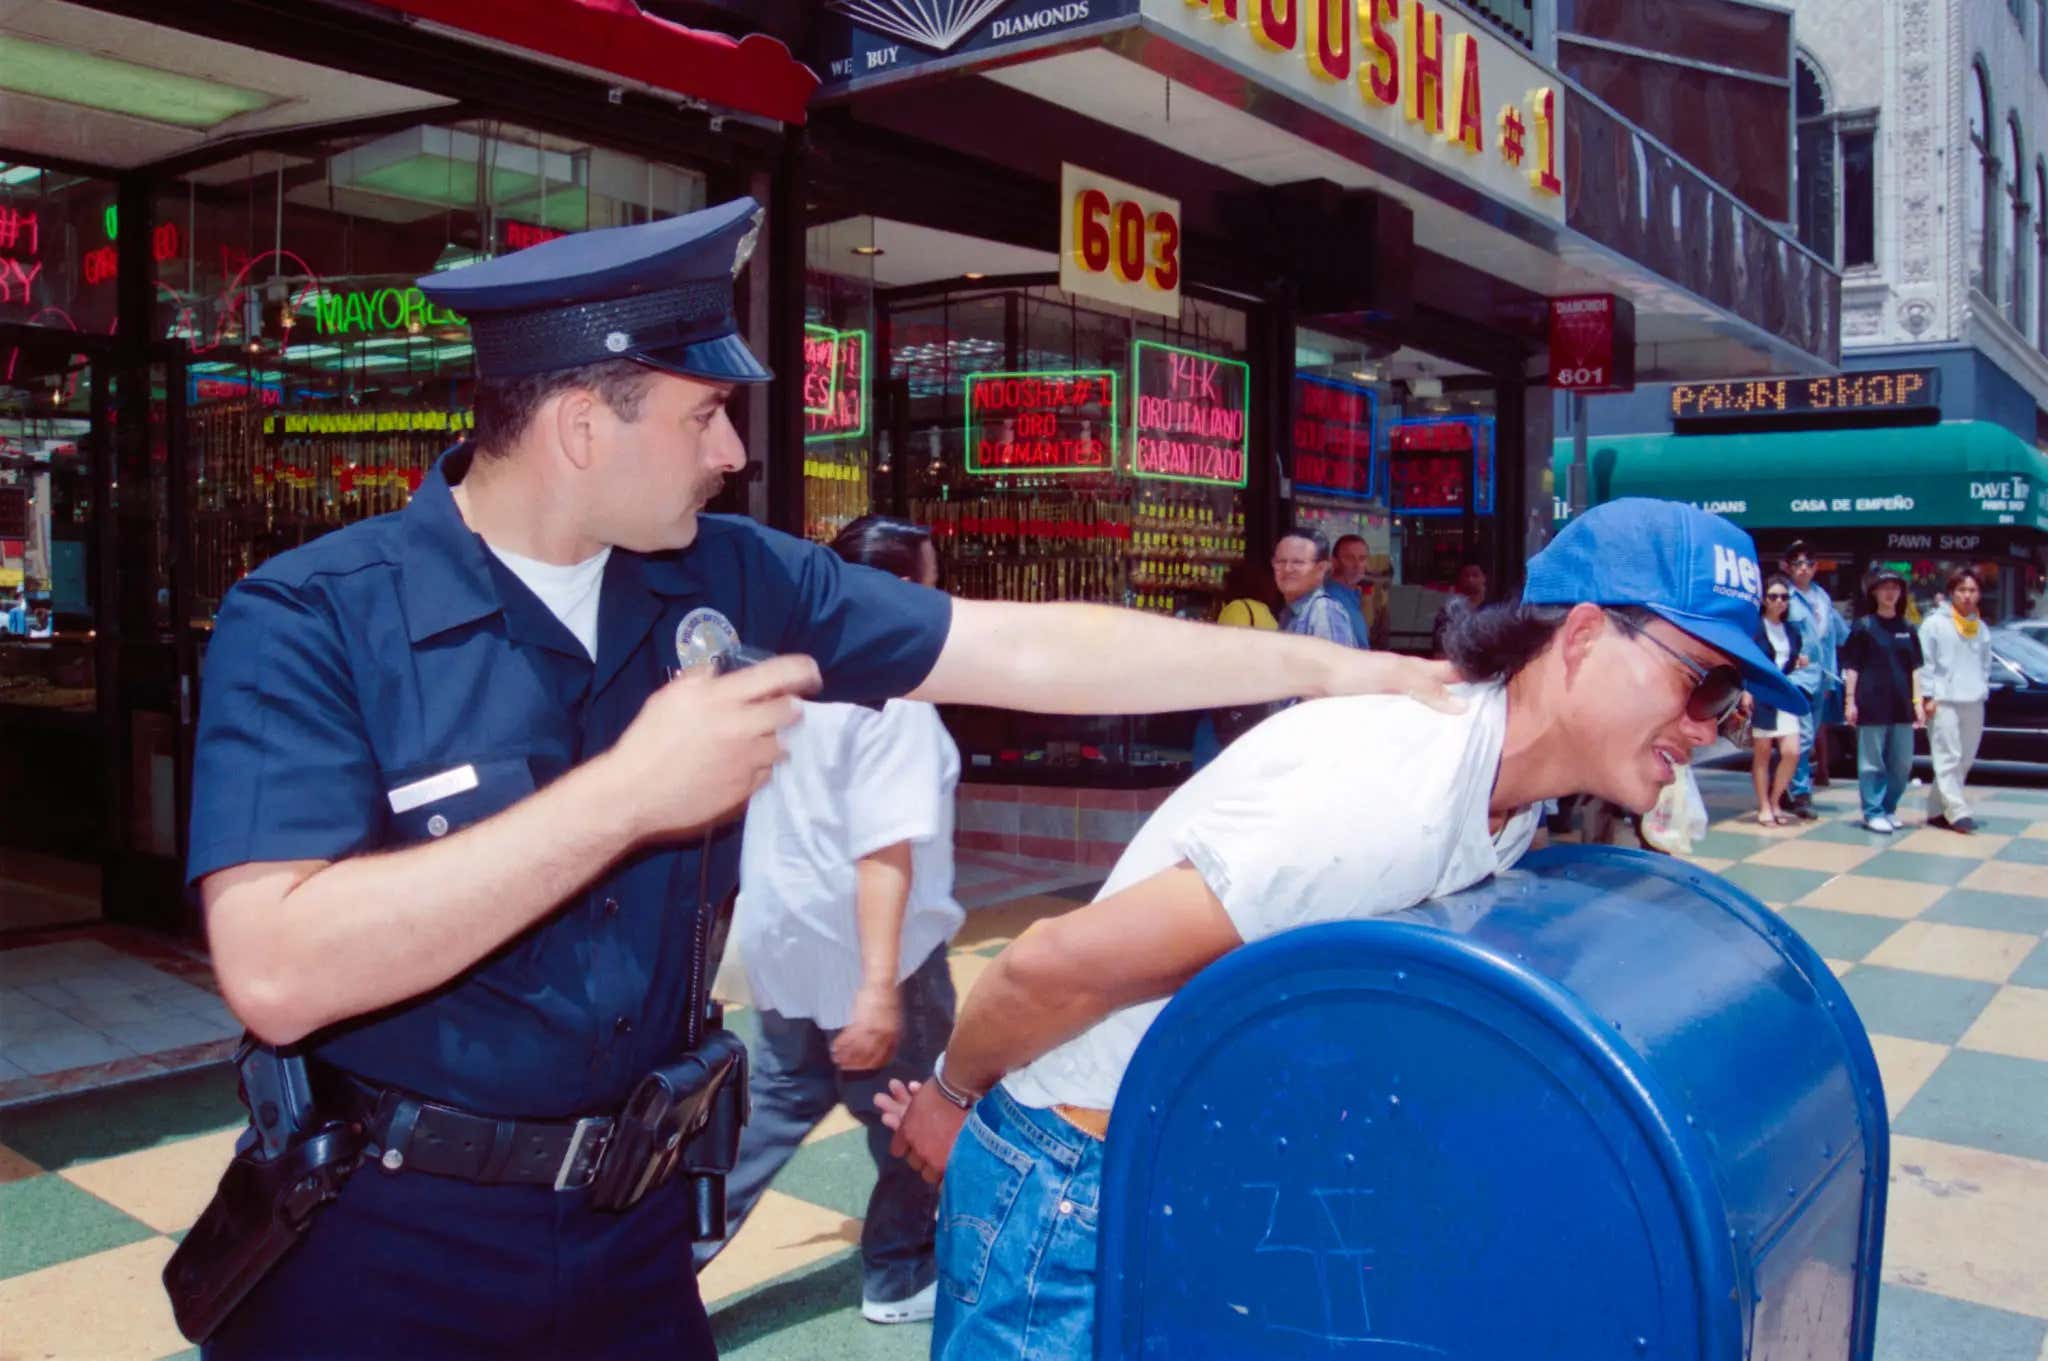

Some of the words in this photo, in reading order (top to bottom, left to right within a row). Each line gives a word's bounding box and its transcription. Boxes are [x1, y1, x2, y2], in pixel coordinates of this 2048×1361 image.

[831, 58, 852, 75] WE
[867, 46, 899, 68] BUY
[992, 1, 1089, 39] DIAMONDS
[1497, 86, 1561, 196] #1
[1073, 189, 1178, 291] 603
[1558, 367, 1602, 385] 601
[1672, 379, 1786, 415] PAWN
[1704, 500, 1748, 513] LOANS
[1790, 499, 1828, 512] CASA
[1832, 499, 1852, 512] DE
[1888, 533, 1932, 548] PAWN
[1939, 534, 1980, 550] SHOP
